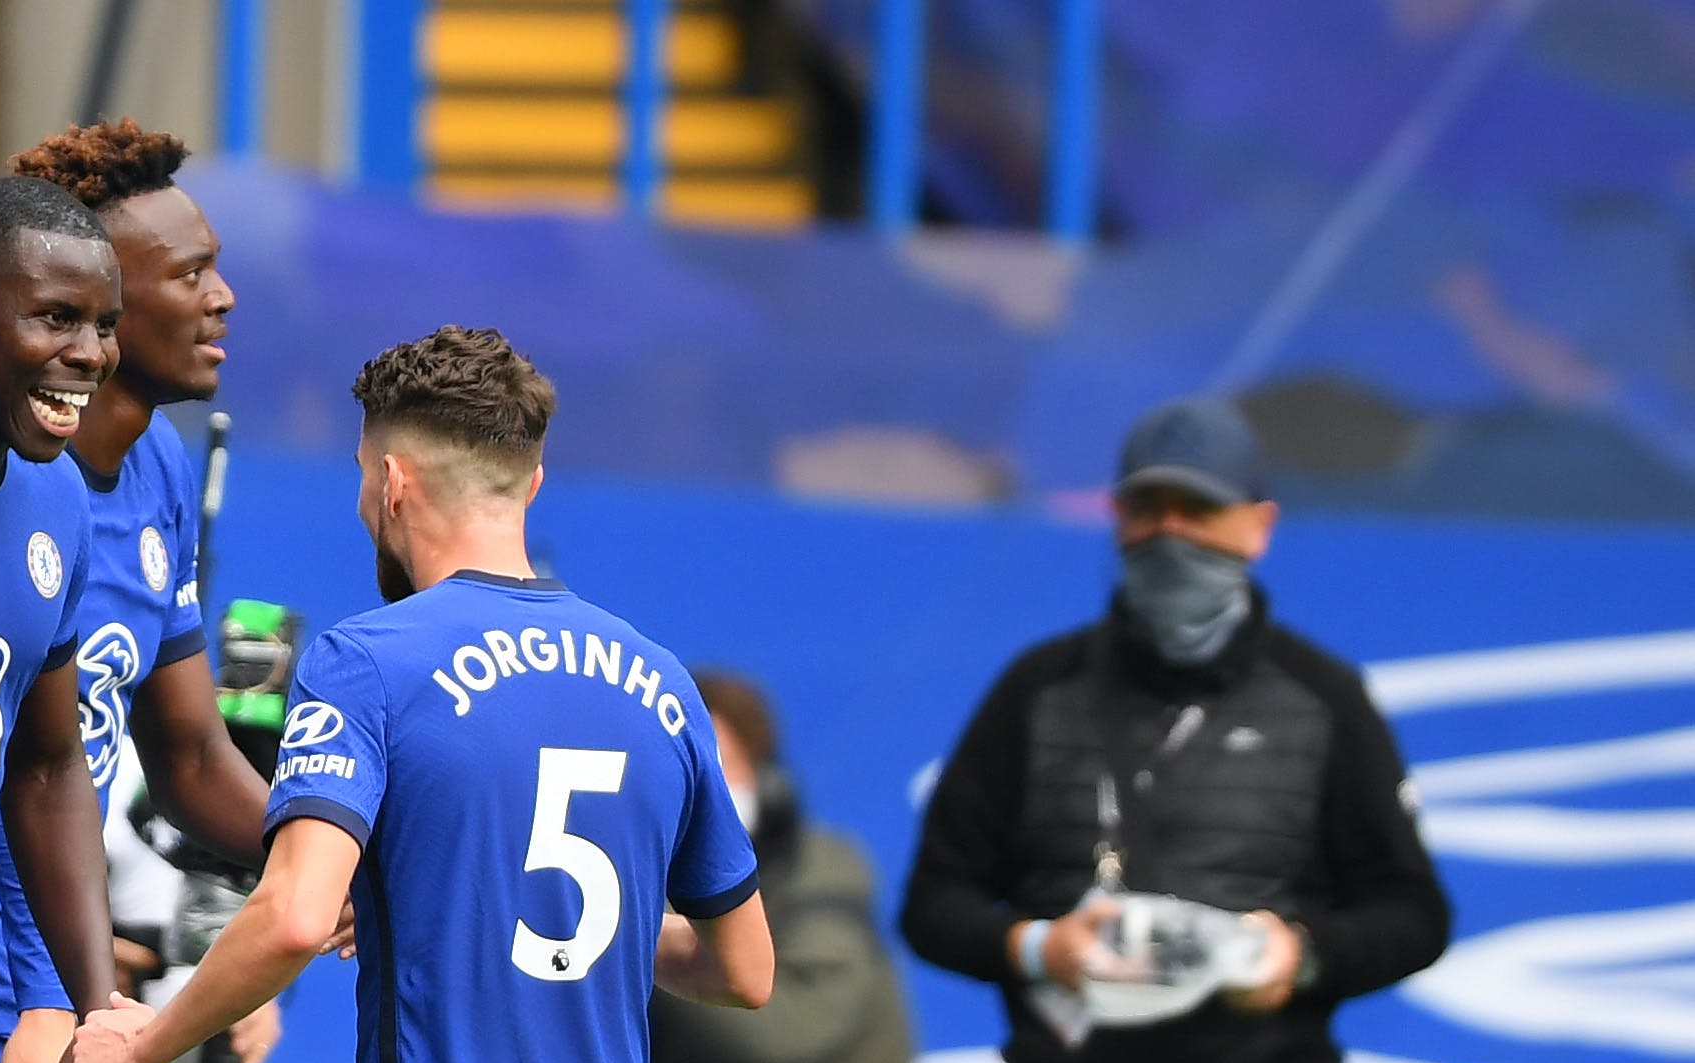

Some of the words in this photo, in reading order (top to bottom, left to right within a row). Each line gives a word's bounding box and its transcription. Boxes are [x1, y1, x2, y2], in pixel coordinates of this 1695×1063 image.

[432, 627, 687, 736] JORGINHO
[270, 753, 356, 791] YUNDAI
[511, 747, 627, 982] 5
